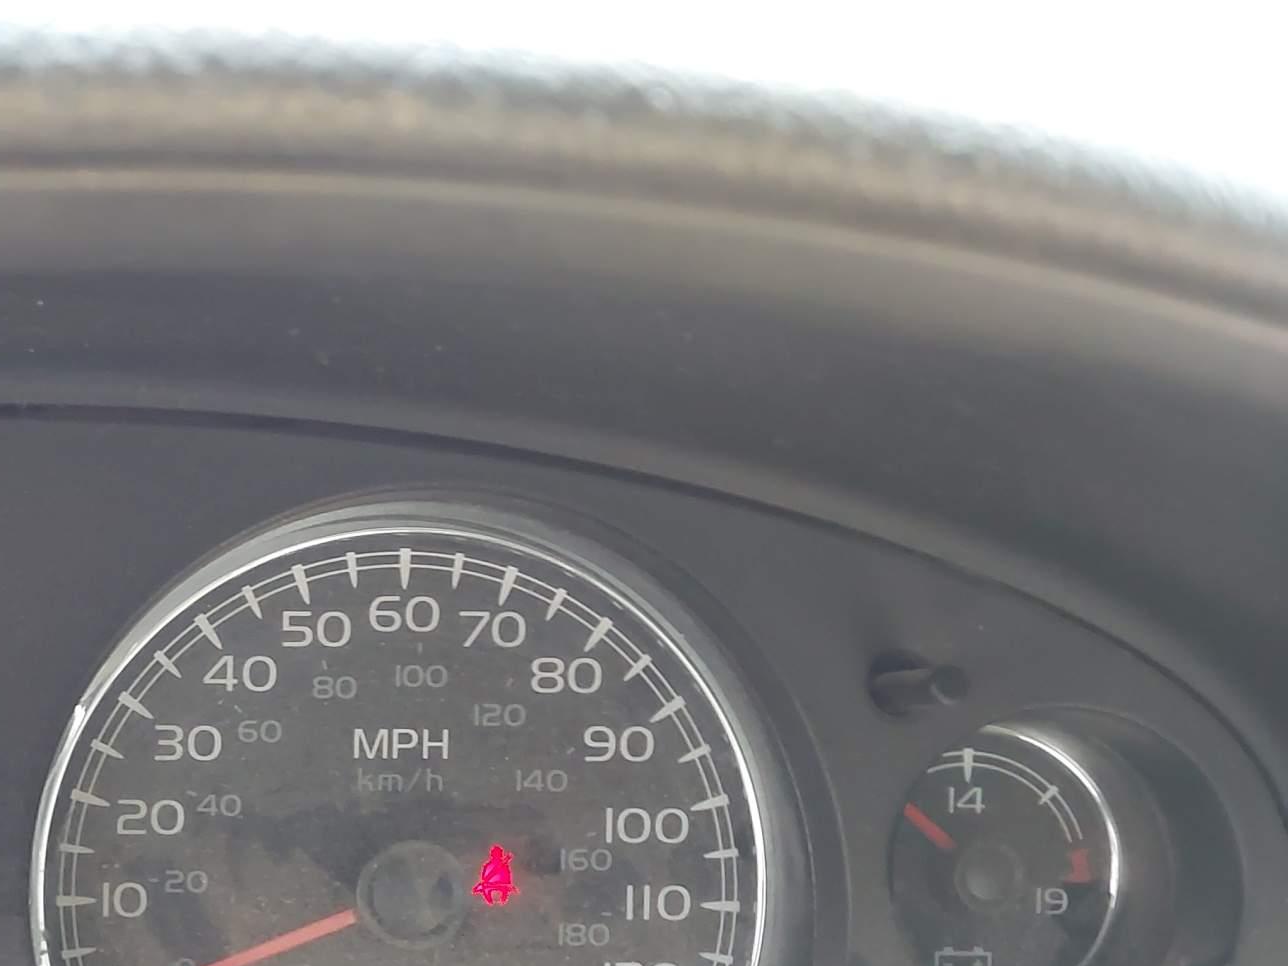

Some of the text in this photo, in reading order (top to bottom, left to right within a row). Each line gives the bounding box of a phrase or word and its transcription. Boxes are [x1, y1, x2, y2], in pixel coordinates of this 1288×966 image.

[369, 595, 441, 632] 60
[281, 610, 352, 647] 50
[458, 610, 526, 648] 70
[202, 655, 278, 691] 40
[312, 675, 357, 699] 80
[394, 665, 448, 688] 100
[530, 657, 603, 694] 80
[472, 703, 527, 727] 120
[153, 724, 222, 761] 30
[237, 719, 282, 743] 60
[353, 729, 450, 760] MPH
[583, 725, 655, 763] 90
[356, 768, 444, 792] km/h
[515, 769, 568, 792] 140
[196, 794, 242, 817] 40
[948, 786, 985, 814] 14
[116, 799, 186, 835] 20
[605, 807, 690, 845] 100
[560, 848, 612, 871] 160
[164, 869, 208, 893] 20
[101, 882, 149, 918] 10
[626, 885, 692, 921] 110
[1035, 887, 1069, 915] 19
[557, 923, 610, 946] 180
